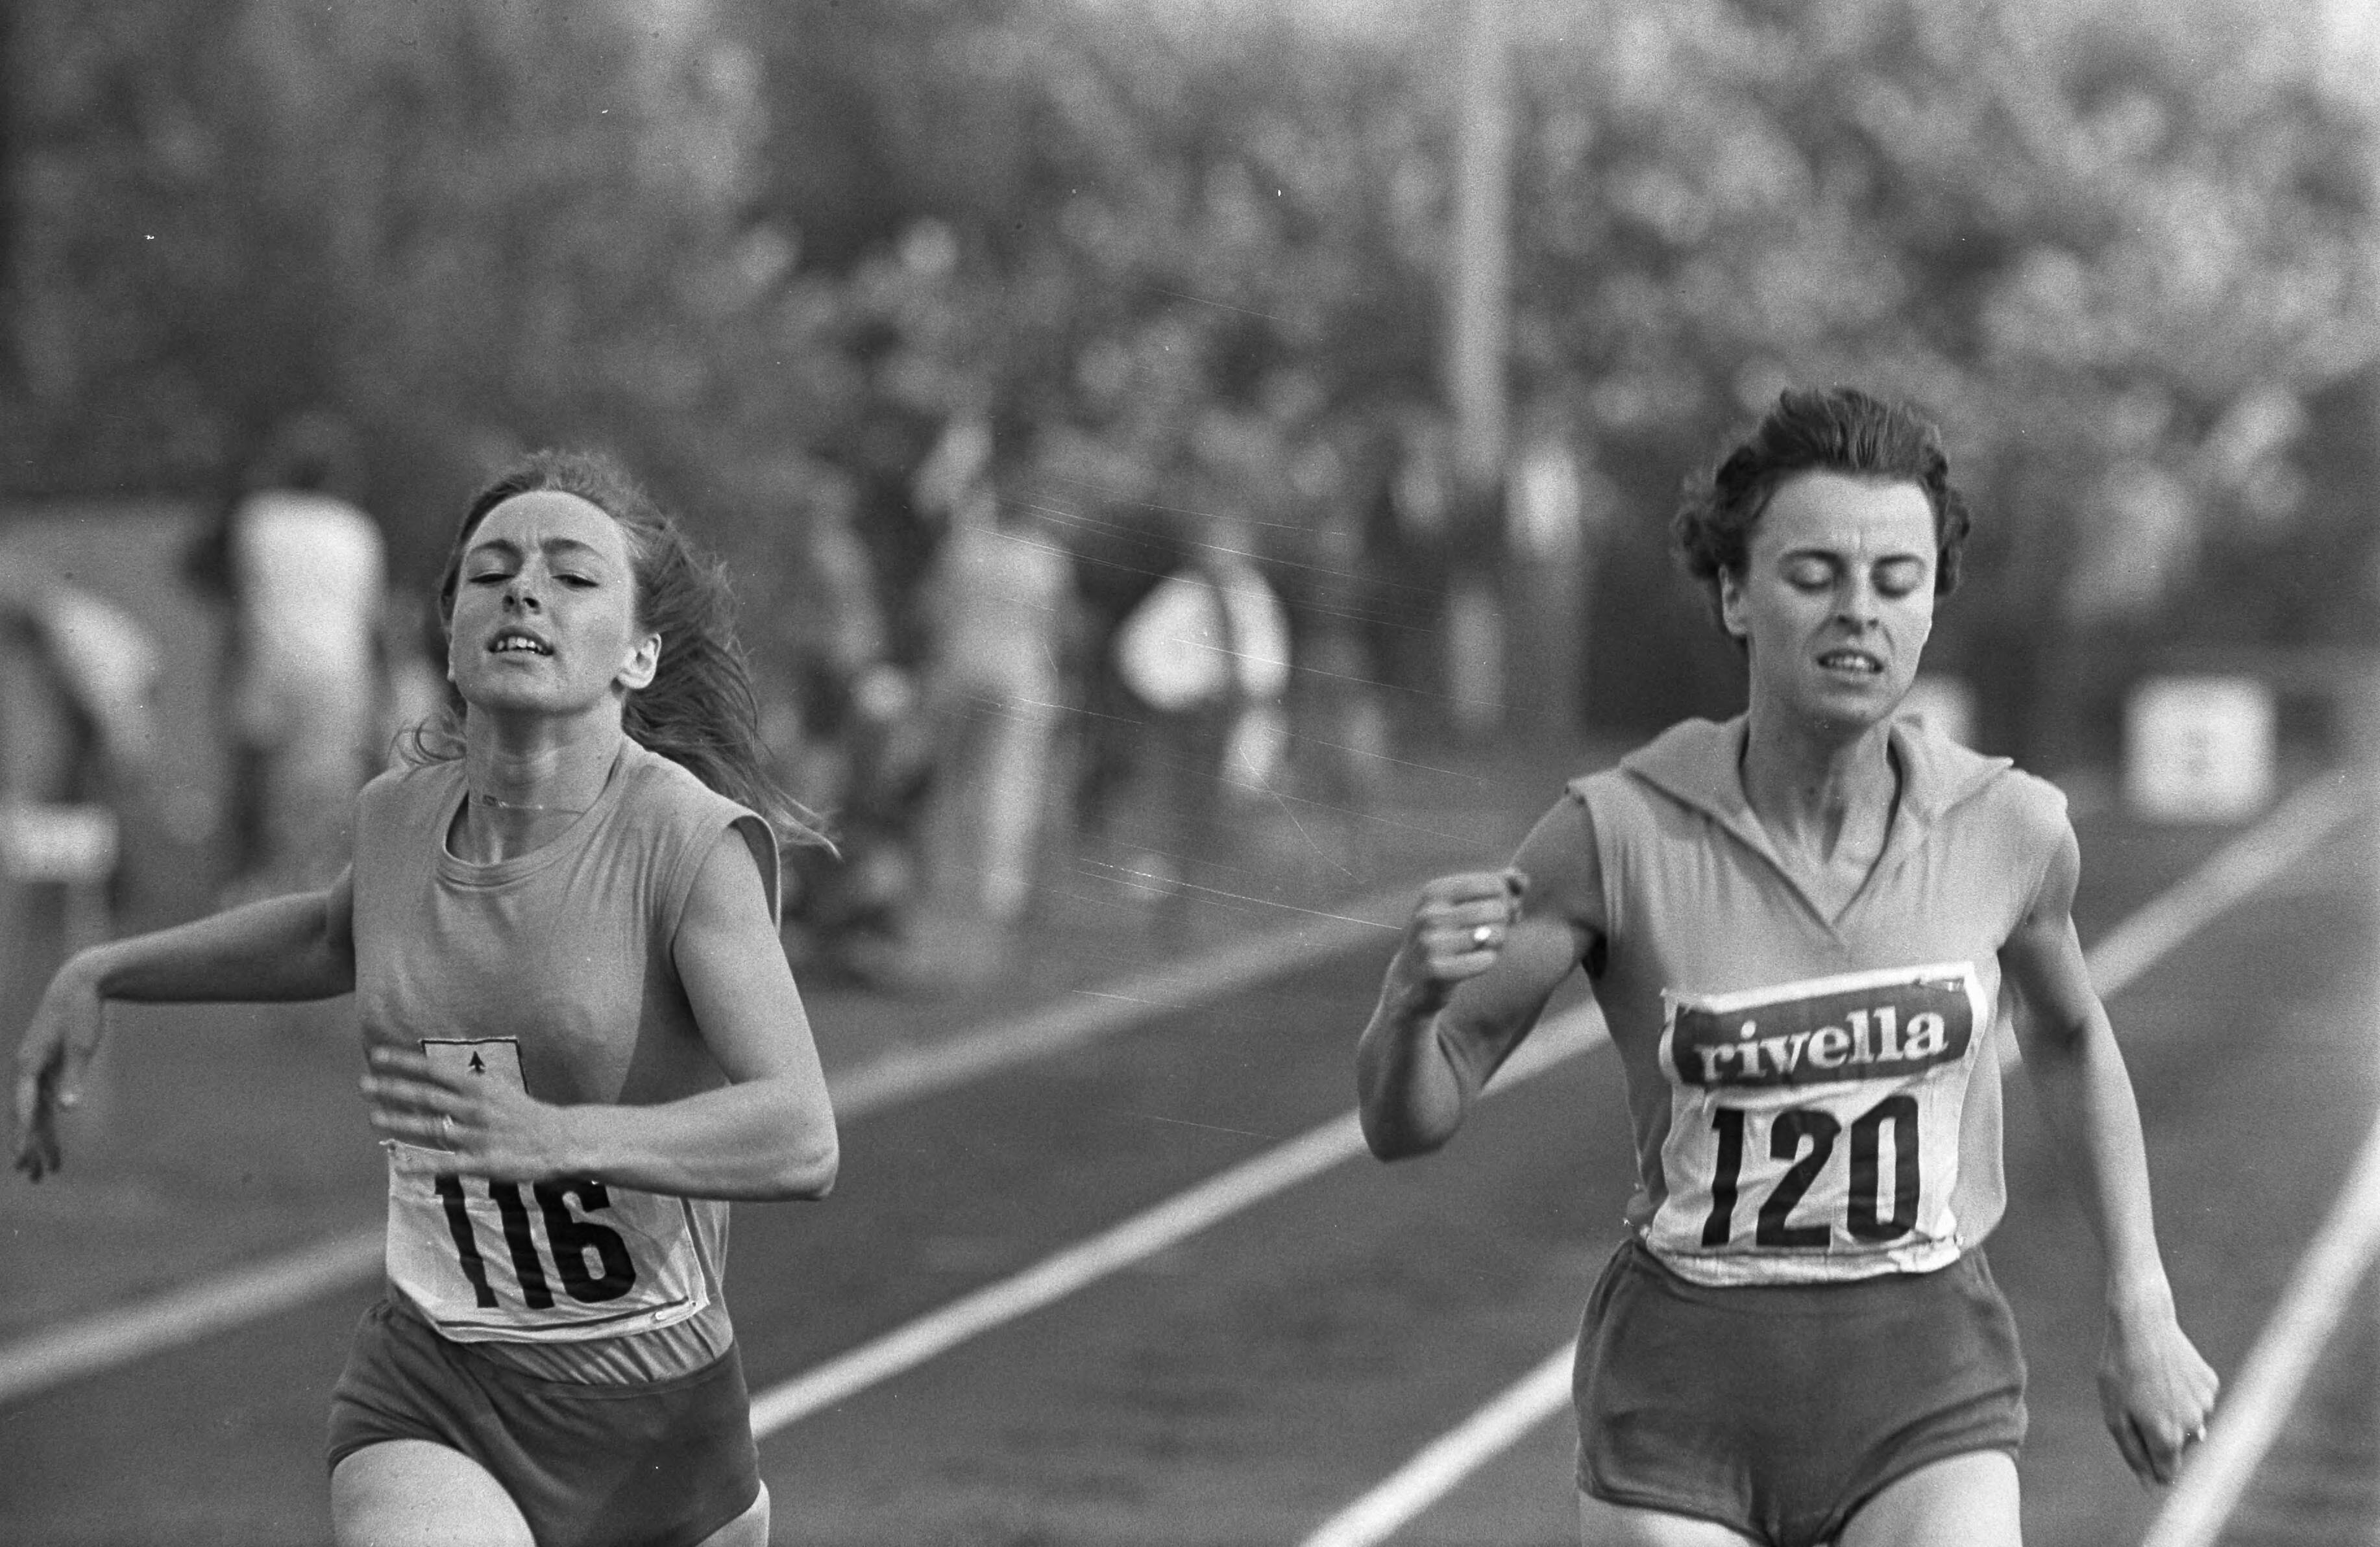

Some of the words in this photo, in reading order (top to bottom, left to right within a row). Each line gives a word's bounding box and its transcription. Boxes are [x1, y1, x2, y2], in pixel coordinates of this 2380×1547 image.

[1693, 1006, 1949, 1082] rivella
[1701, 1094, 1920, 1248] 120
[434, 1172, 637, 1309] 116
